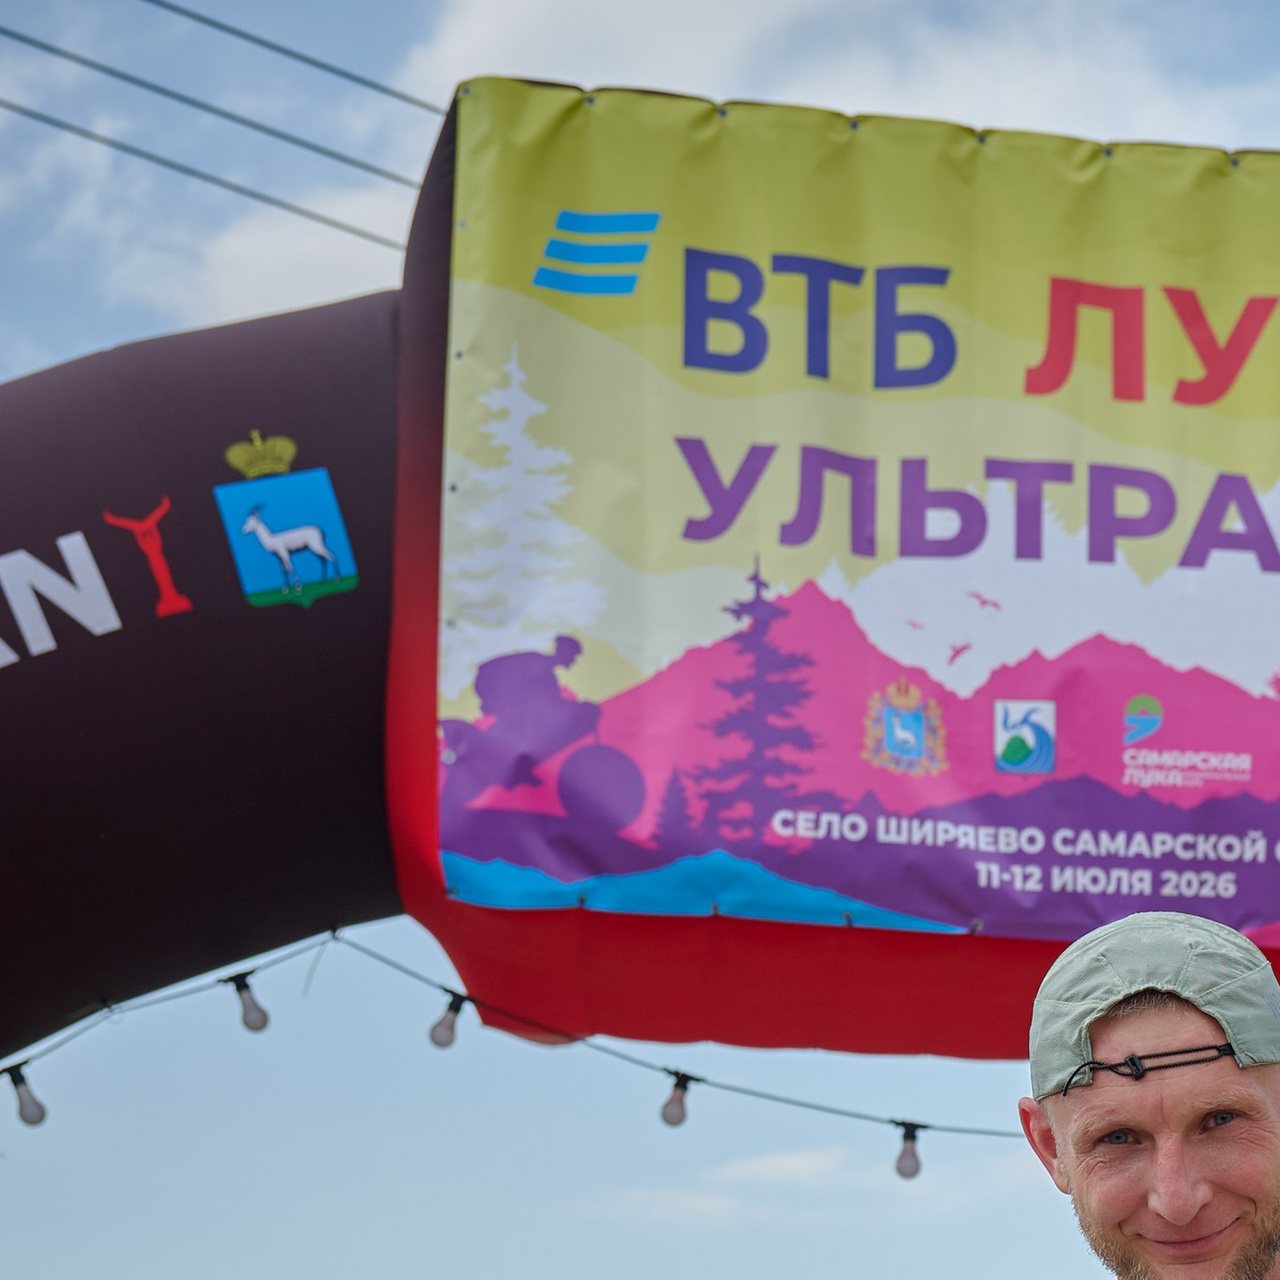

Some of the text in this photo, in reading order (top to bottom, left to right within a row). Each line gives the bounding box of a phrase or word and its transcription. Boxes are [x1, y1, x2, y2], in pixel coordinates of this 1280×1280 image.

[682, 246, 958, 389] ВТБ
[1122, 748, 1251, 771] САМАРСКАЯ
[1122, 768, 1182, 787] ЛУКА
[772, 808, 868, 841] СЕЛО
[876, 817, 1045, 855] ШИРЯЕВО
[1052, 828, 1267, 864] САМАРСКОЙ
[975, 862, 1237, 898] 11-12 ИЮЛЯ 2026
